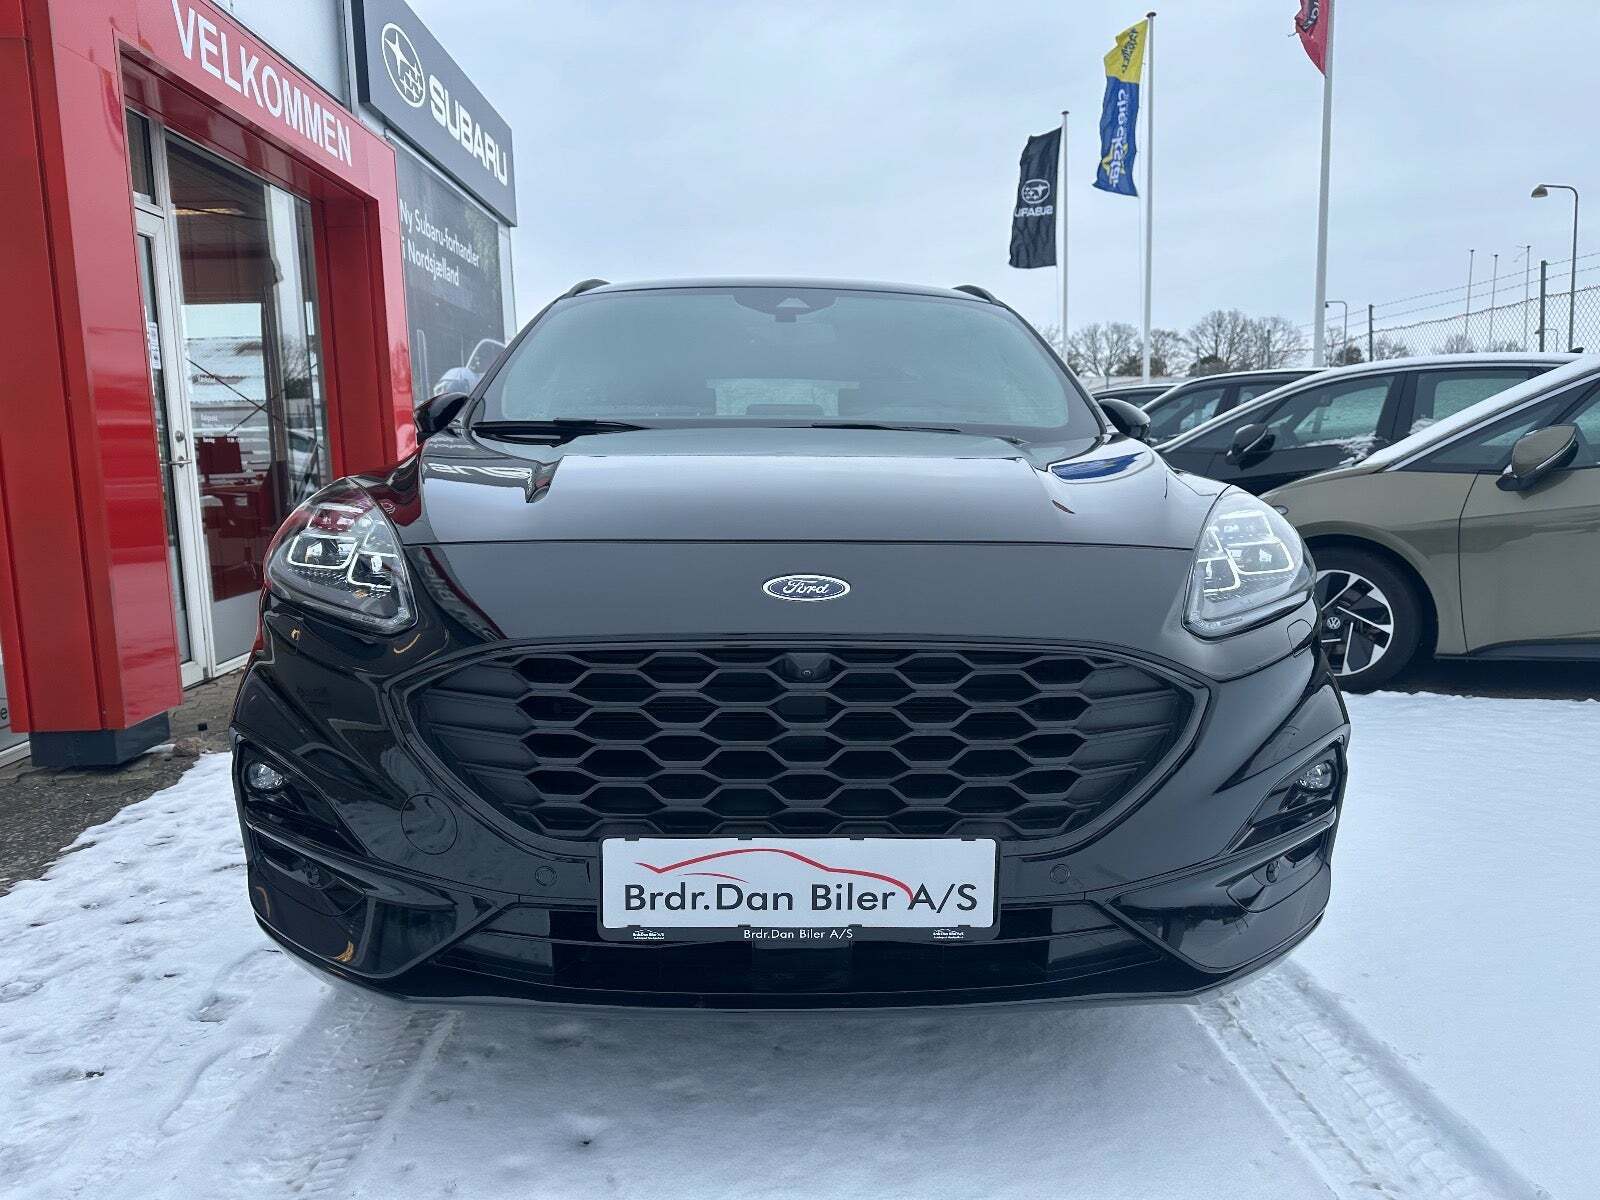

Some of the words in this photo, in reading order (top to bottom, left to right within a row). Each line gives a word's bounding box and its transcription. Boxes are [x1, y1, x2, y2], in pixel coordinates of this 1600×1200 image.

[172, 0, 352, 167] VELKOMMEN
[429, 74, 508, 186] SUBARU
[400, 198, 413, 234] Ny
[415, 208, 480, 268] Subaru-forhandler
[408, 238, 459, 287] Nordsjælland
[782, 579, 830, 594] Ford
[624, 881, 794, 911] Brdr.Dan
[811, 882, 896, 911] Biler
[907, 883, 978, 913] A/S
[743, 928, 795, 939] Brdr.Dan
[799, 928, 826, 939] Biler
[829, 928, 854, 940] A/S
